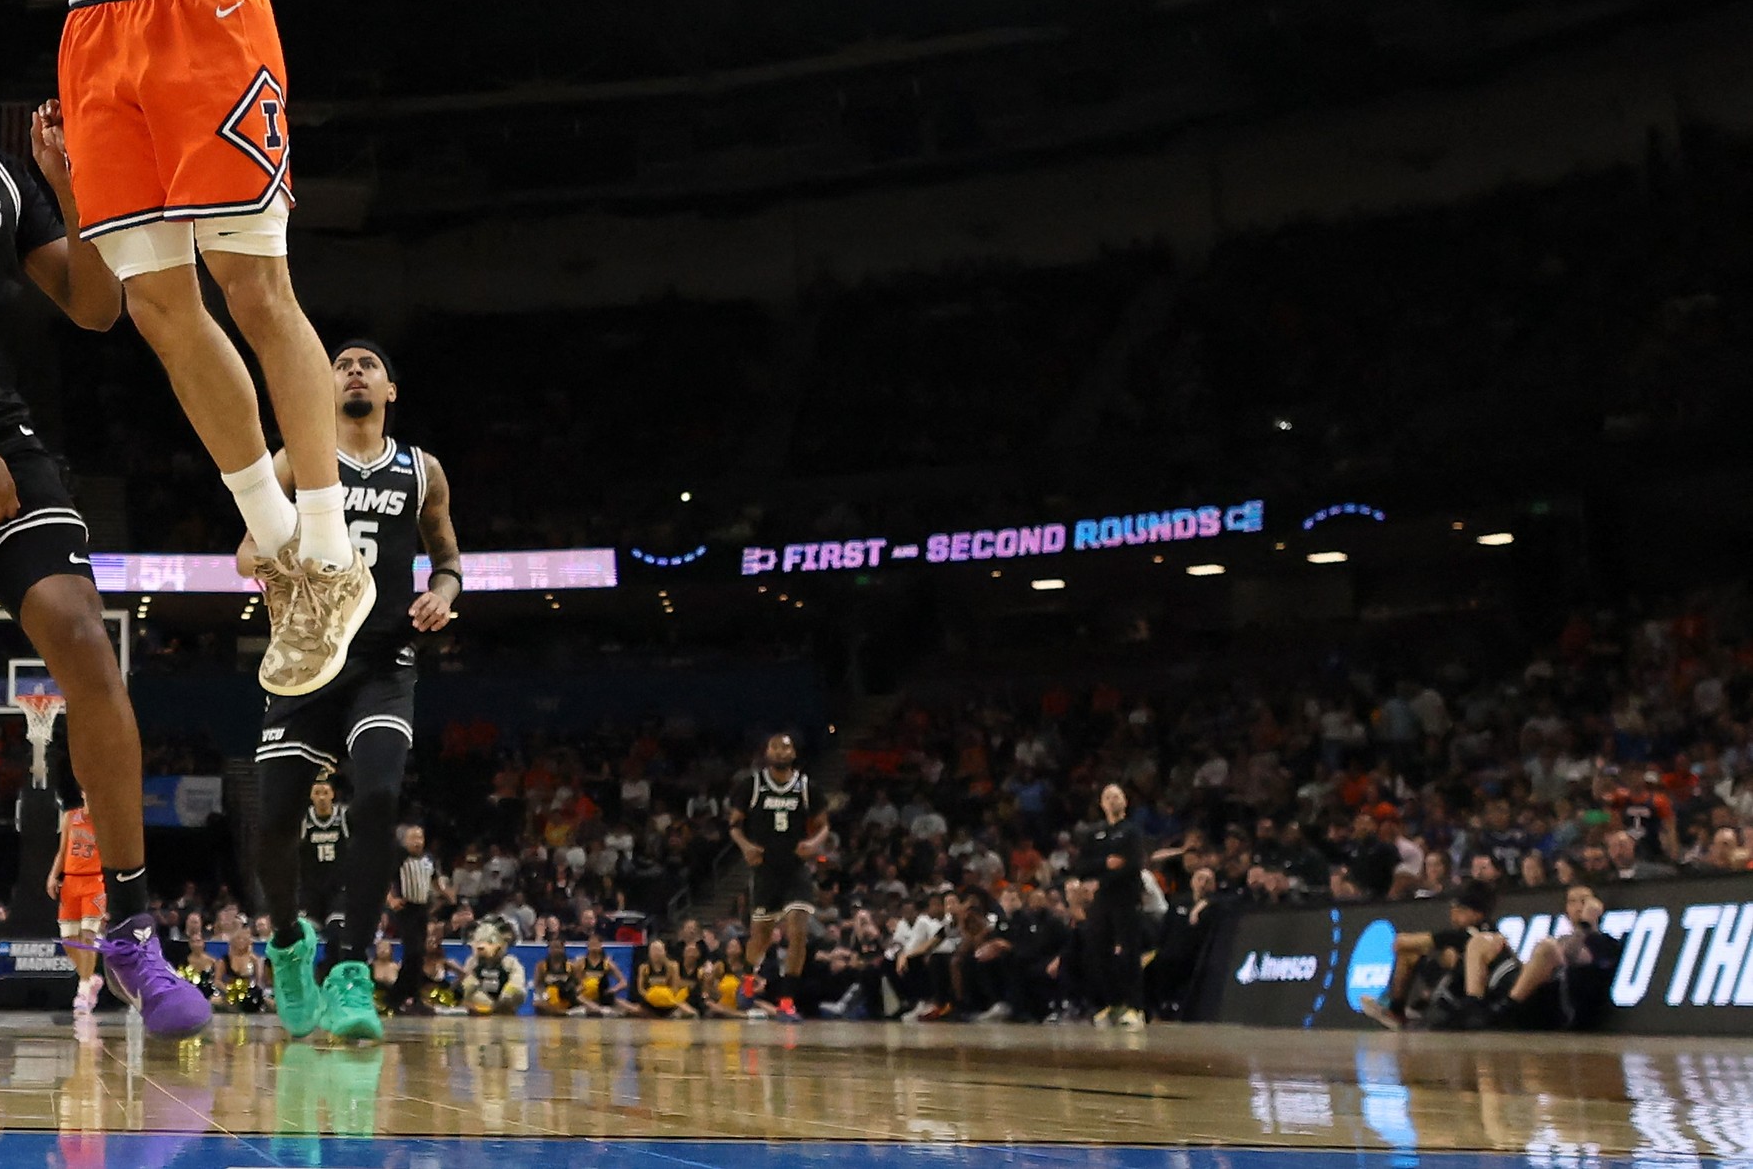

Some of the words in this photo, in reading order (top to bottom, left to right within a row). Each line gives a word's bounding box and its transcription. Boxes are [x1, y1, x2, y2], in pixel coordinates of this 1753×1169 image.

[341, 485, 408, 517] AMS
[781, 536, 889, 573] FIRST
[924, 522, 1067, 563] SECOND
[1072, 504, 1224, 552] ROUNDS
[261, 728, 286, 742] VCU
[316, 843, 336, 862] 15
[9, 943, 56, 958] MARCH
[1349, 964, 1393, 988] NCAA
